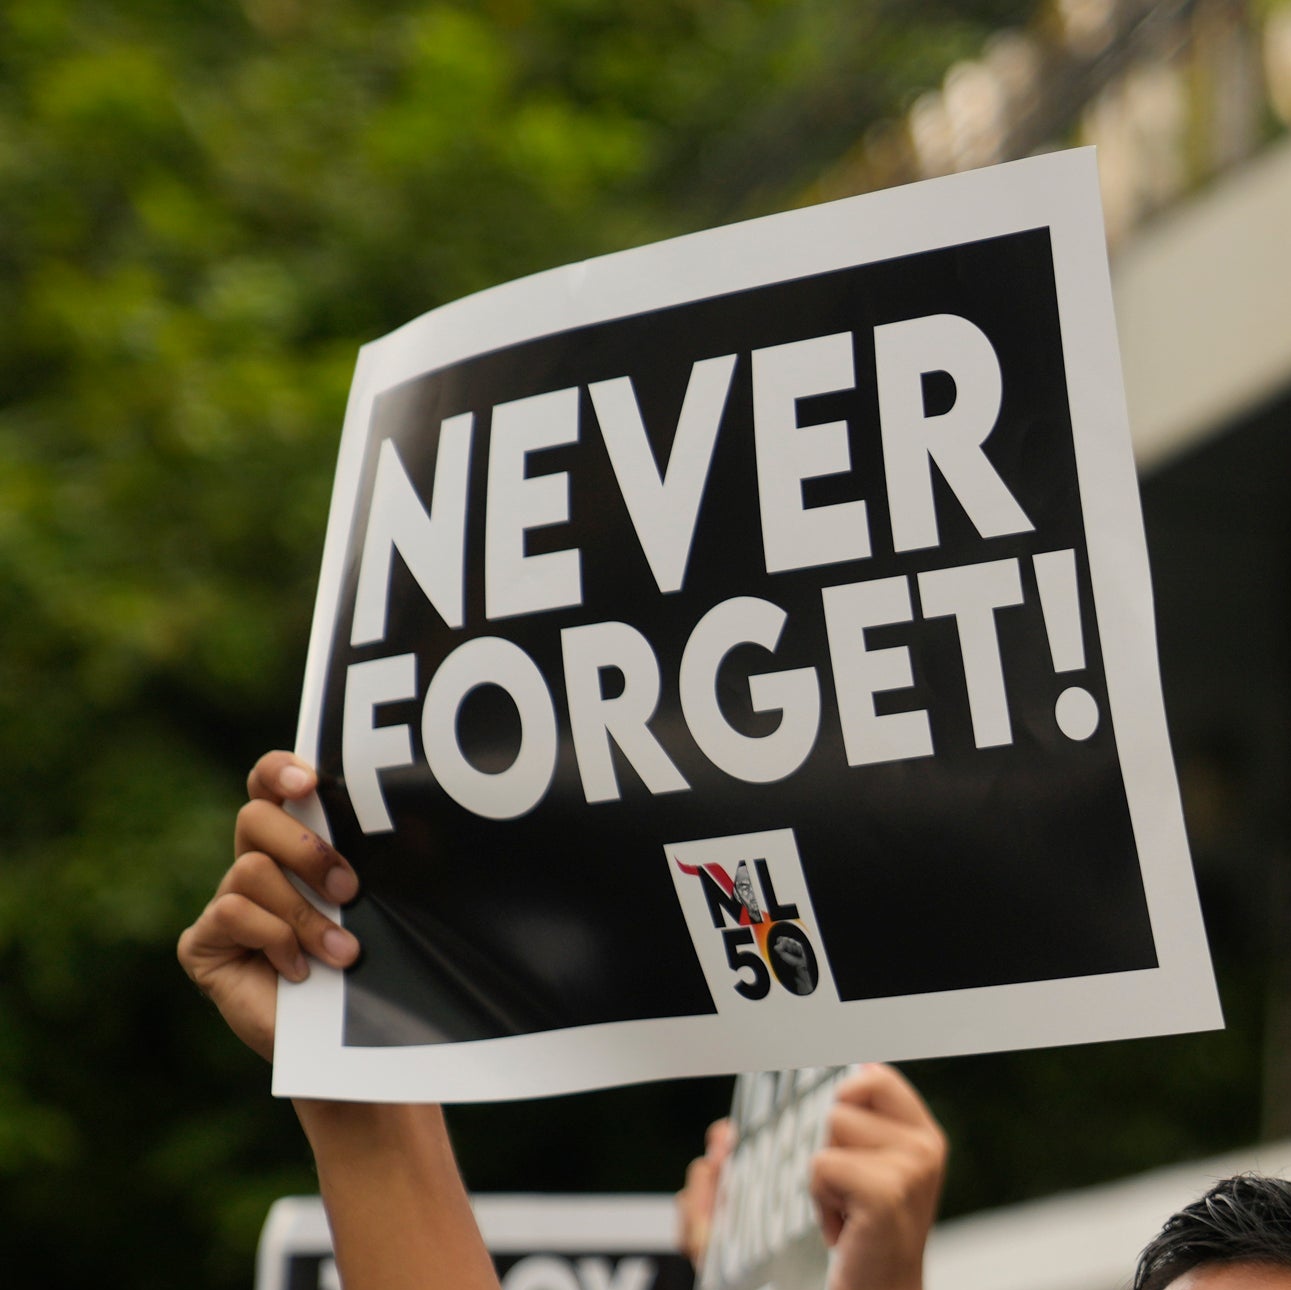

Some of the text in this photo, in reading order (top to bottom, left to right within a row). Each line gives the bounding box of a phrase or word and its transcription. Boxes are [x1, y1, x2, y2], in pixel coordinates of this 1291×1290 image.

[350, 313, 1036, 647] NEVER
[342, 548, 1100, 836] FORGET!
[721, 921, 819, 1001] 50
